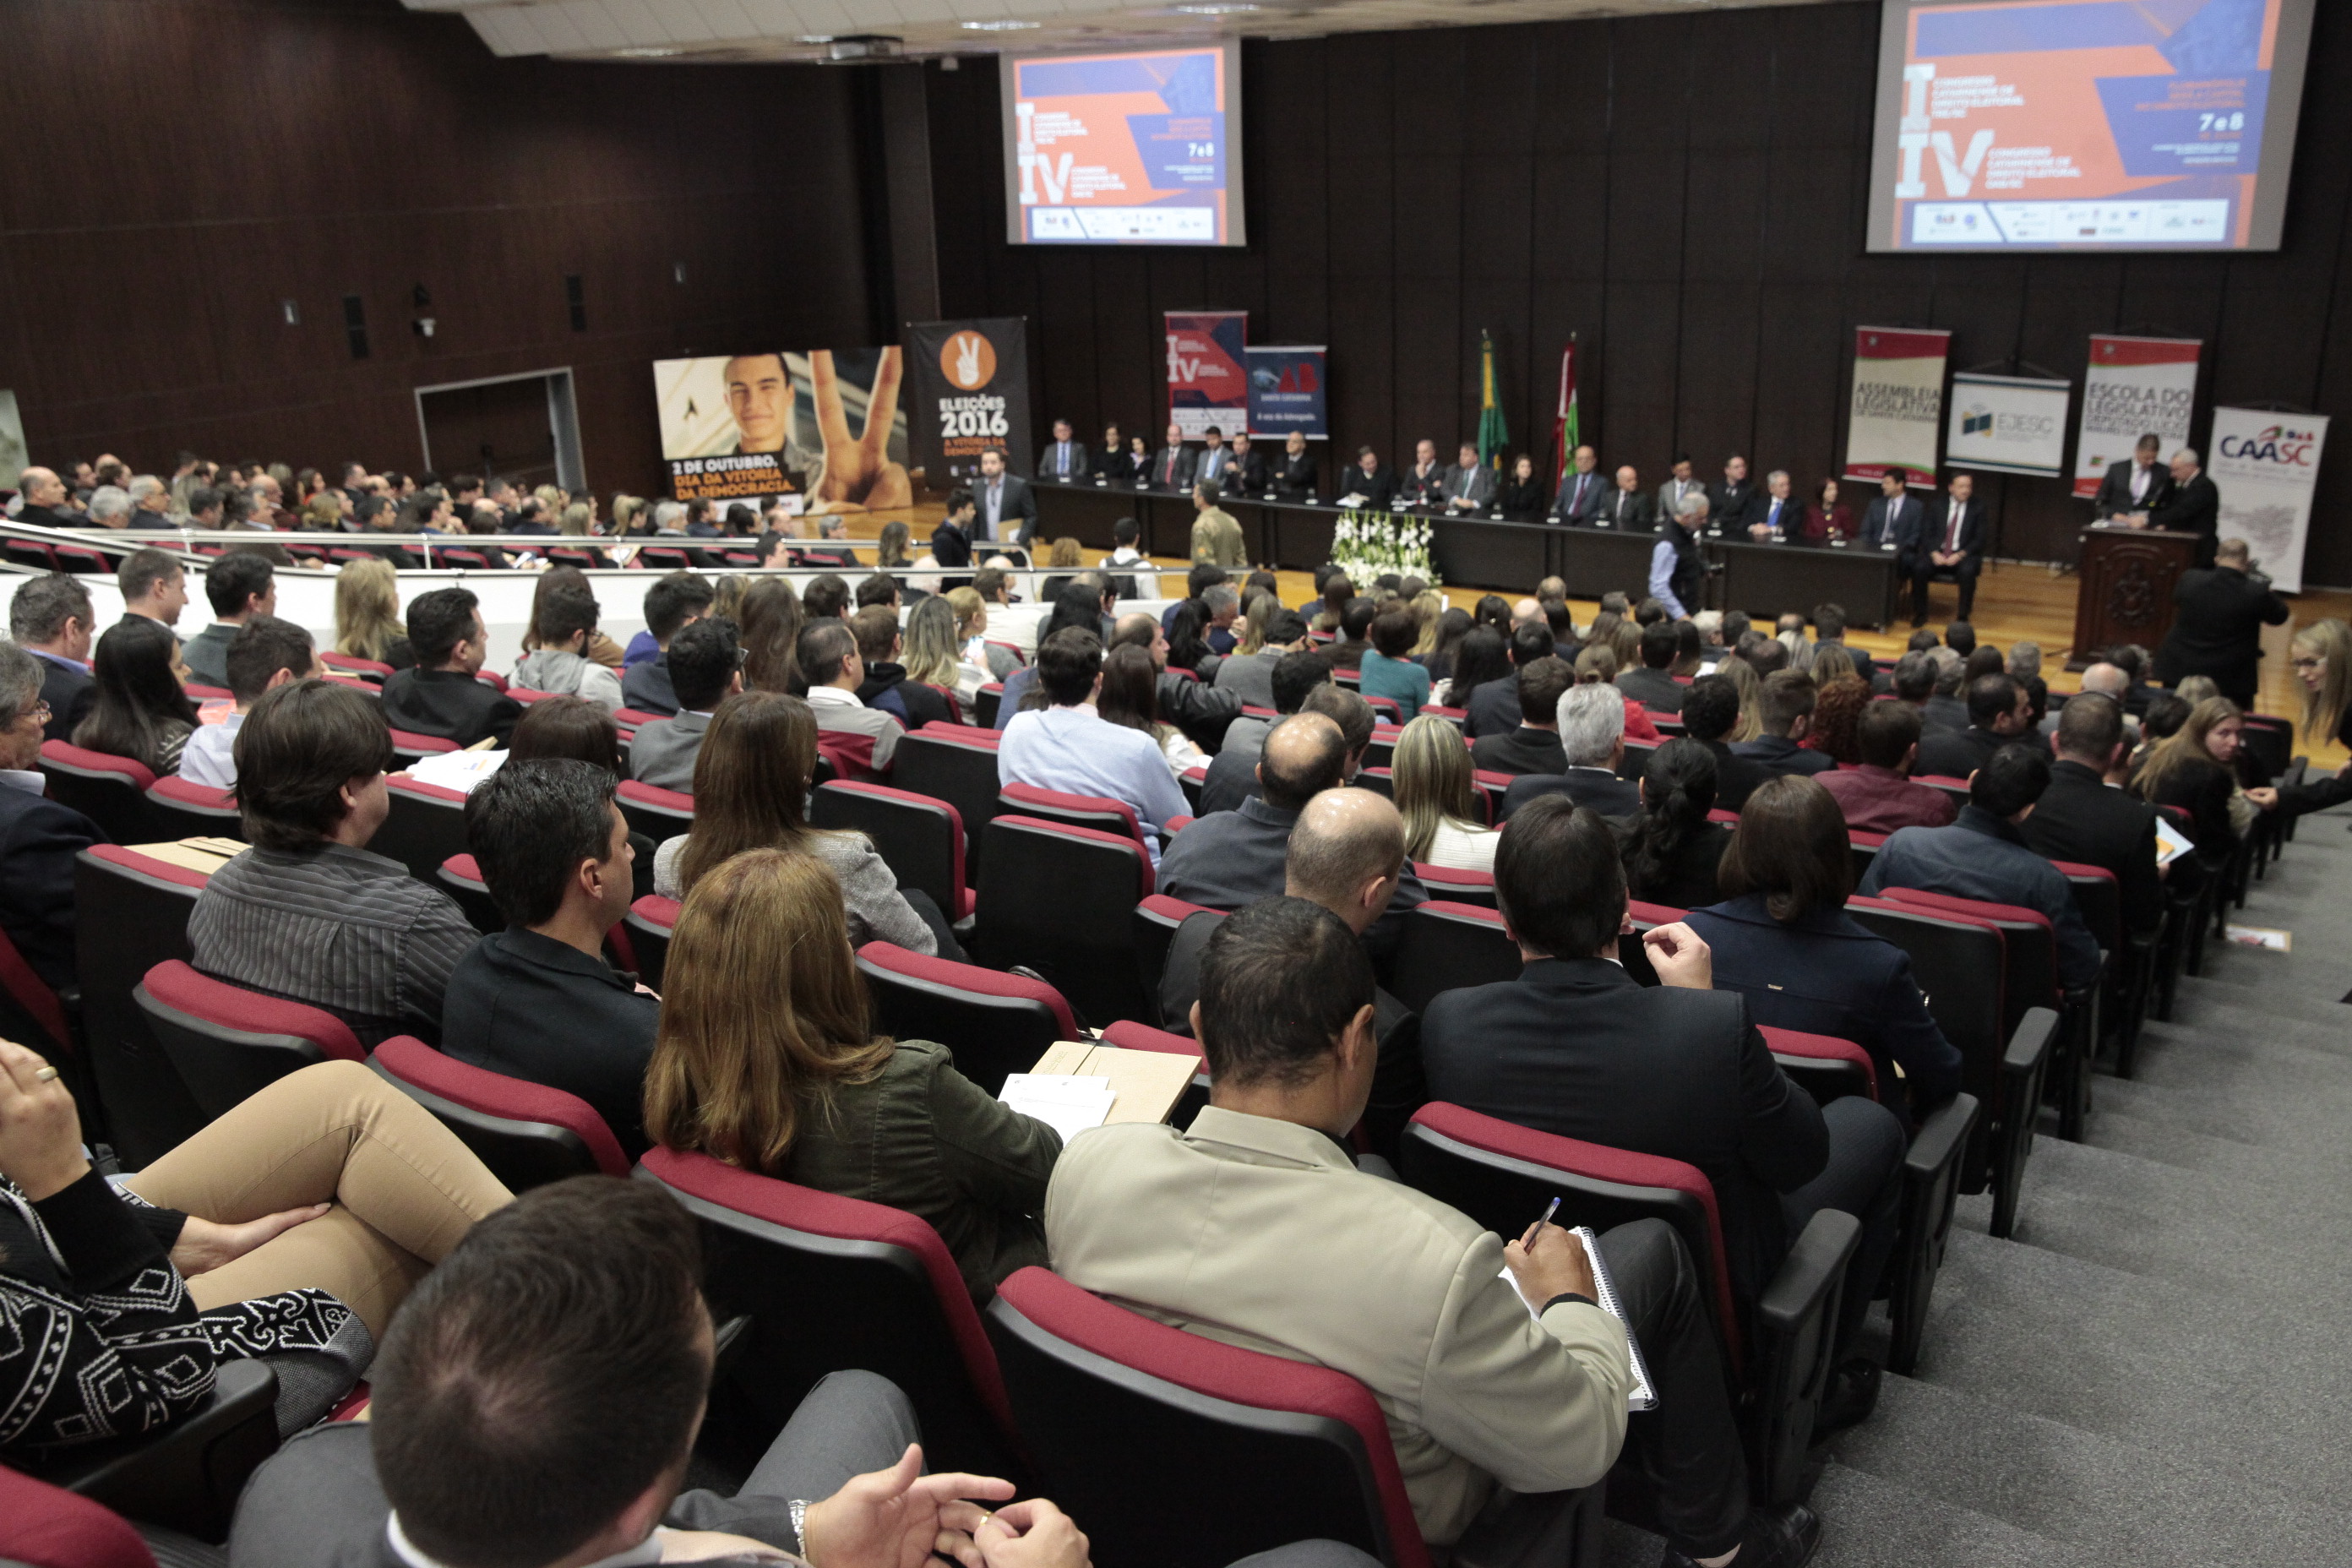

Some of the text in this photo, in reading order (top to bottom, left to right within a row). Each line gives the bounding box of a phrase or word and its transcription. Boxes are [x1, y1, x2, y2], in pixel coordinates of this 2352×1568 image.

[1895, 128, 1995, 199] IV
[1018, 152, 1074, 204] IV
[1167, 358, 1200, 383] IV
[939, 393, 1006, 412] ELEIÇÕES
[2088, 382, 2191, 405] ESCOLA DO
[939, 411, 1010, 438] 2016
[2220, 435, 2312, 466] CAASC
[672, 454, 778, 475] 2 DE OUTUBRO.
[673, 473, 702, 487] DIA
[703, 471, 724, 485] DA
[676, 479, 796, 500] DA DEMOCRACIA.
